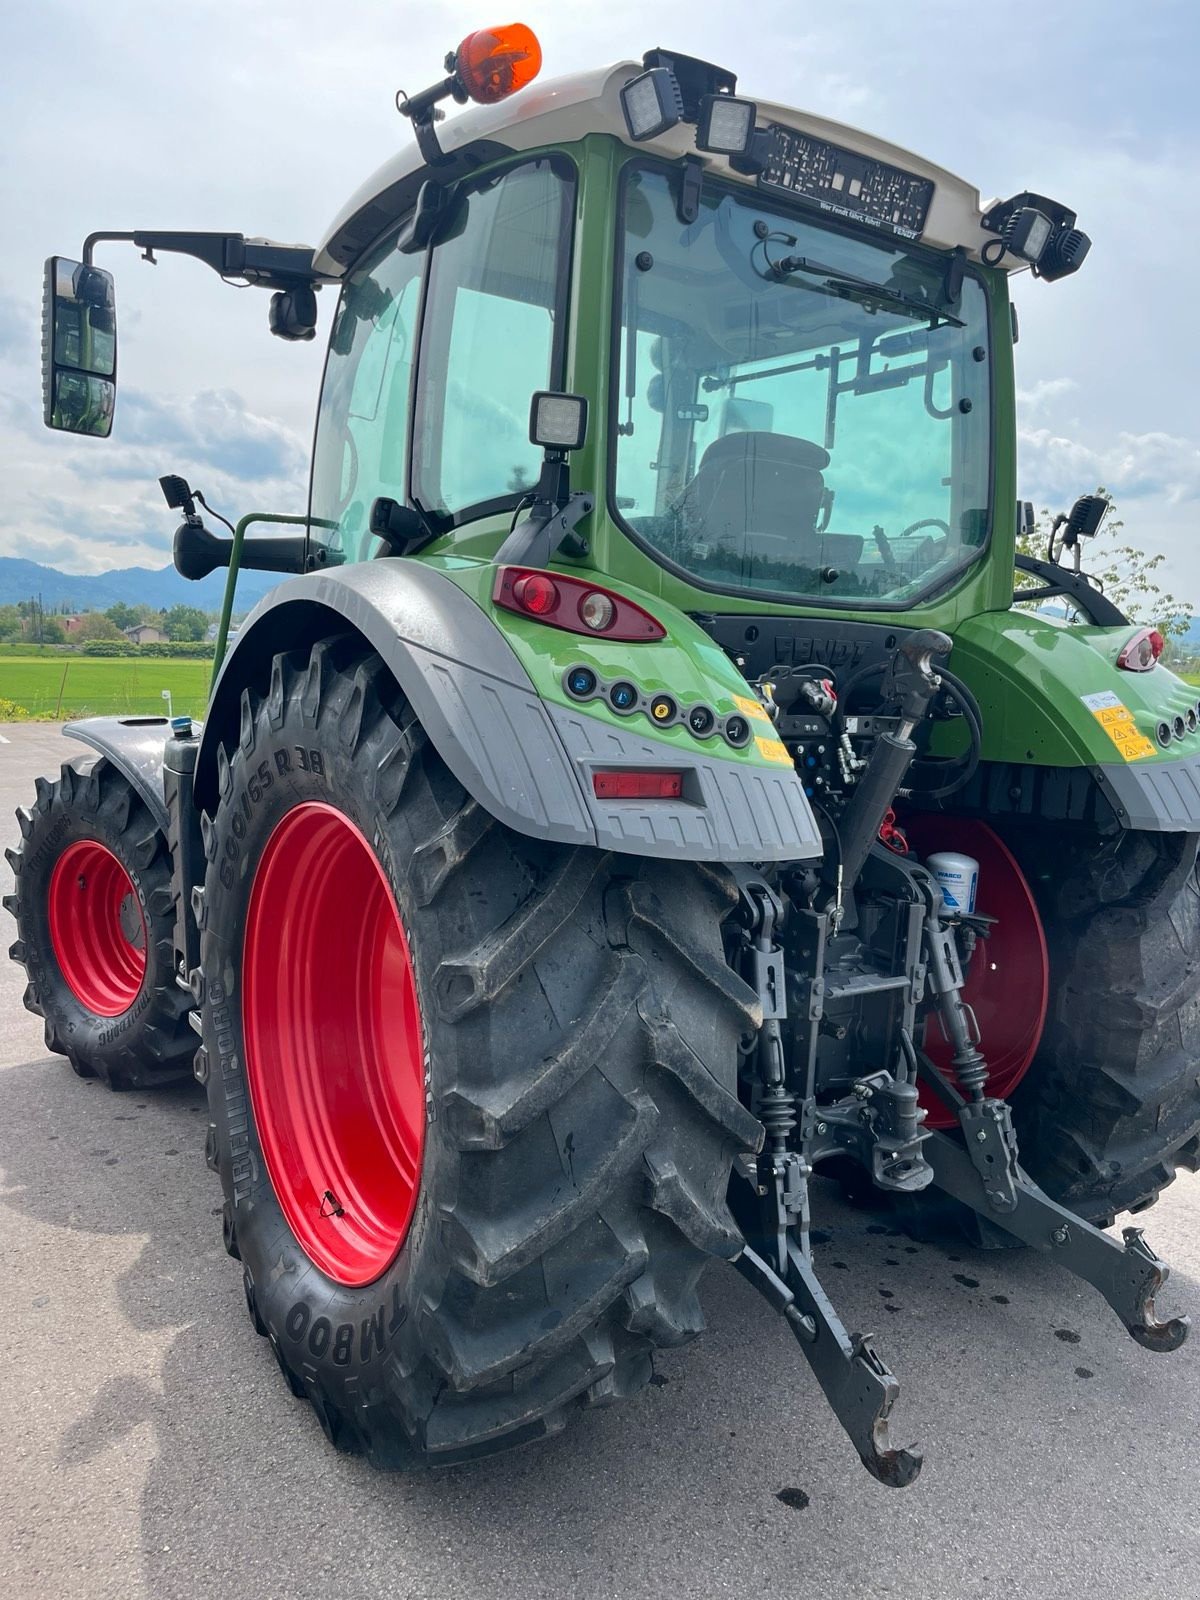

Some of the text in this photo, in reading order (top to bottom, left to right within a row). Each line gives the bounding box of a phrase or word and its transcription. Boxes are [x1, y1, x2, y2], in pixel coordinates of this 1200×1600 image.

[831, 205, 849, 217] Fendt
[893, 225, 918, 240] FENDT
[774, 636, 873, 668] FENDT
[219, 760, 274, 890] 600/65
[294, 744, 325, 776] 38
[937, 871, 962, 879] WABCO
[208, 979, 250, 1209] TRELLEBORG
[285, 1282, 408, 1368] TM800
